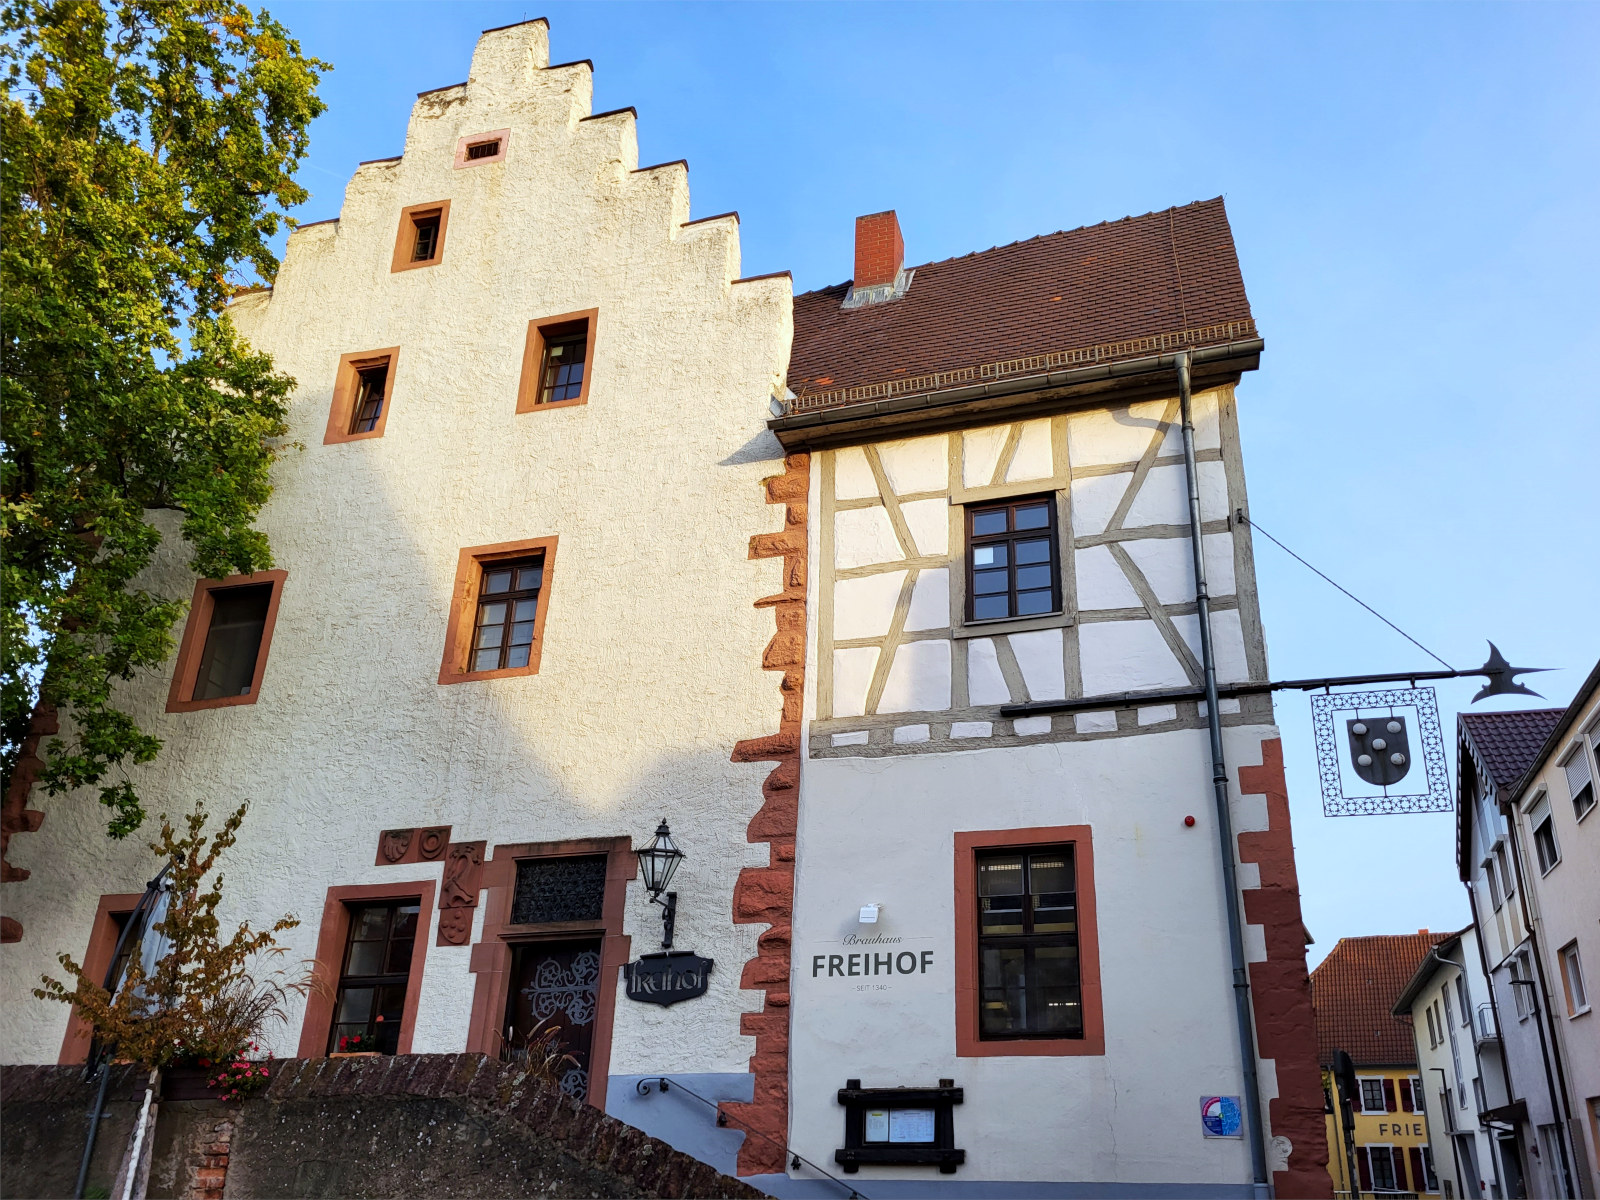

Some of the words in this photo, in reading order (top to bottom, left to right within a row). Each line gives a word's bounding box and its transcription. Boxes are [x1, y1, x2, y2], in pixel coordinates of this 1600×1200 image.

[842, 933, 902, 946] Brauhaus
[812, 950, 934, 978] FREIHOF
[856, 984, 870, 992] SEIT
[1379, 1123, 1423, 1136] FRIE
